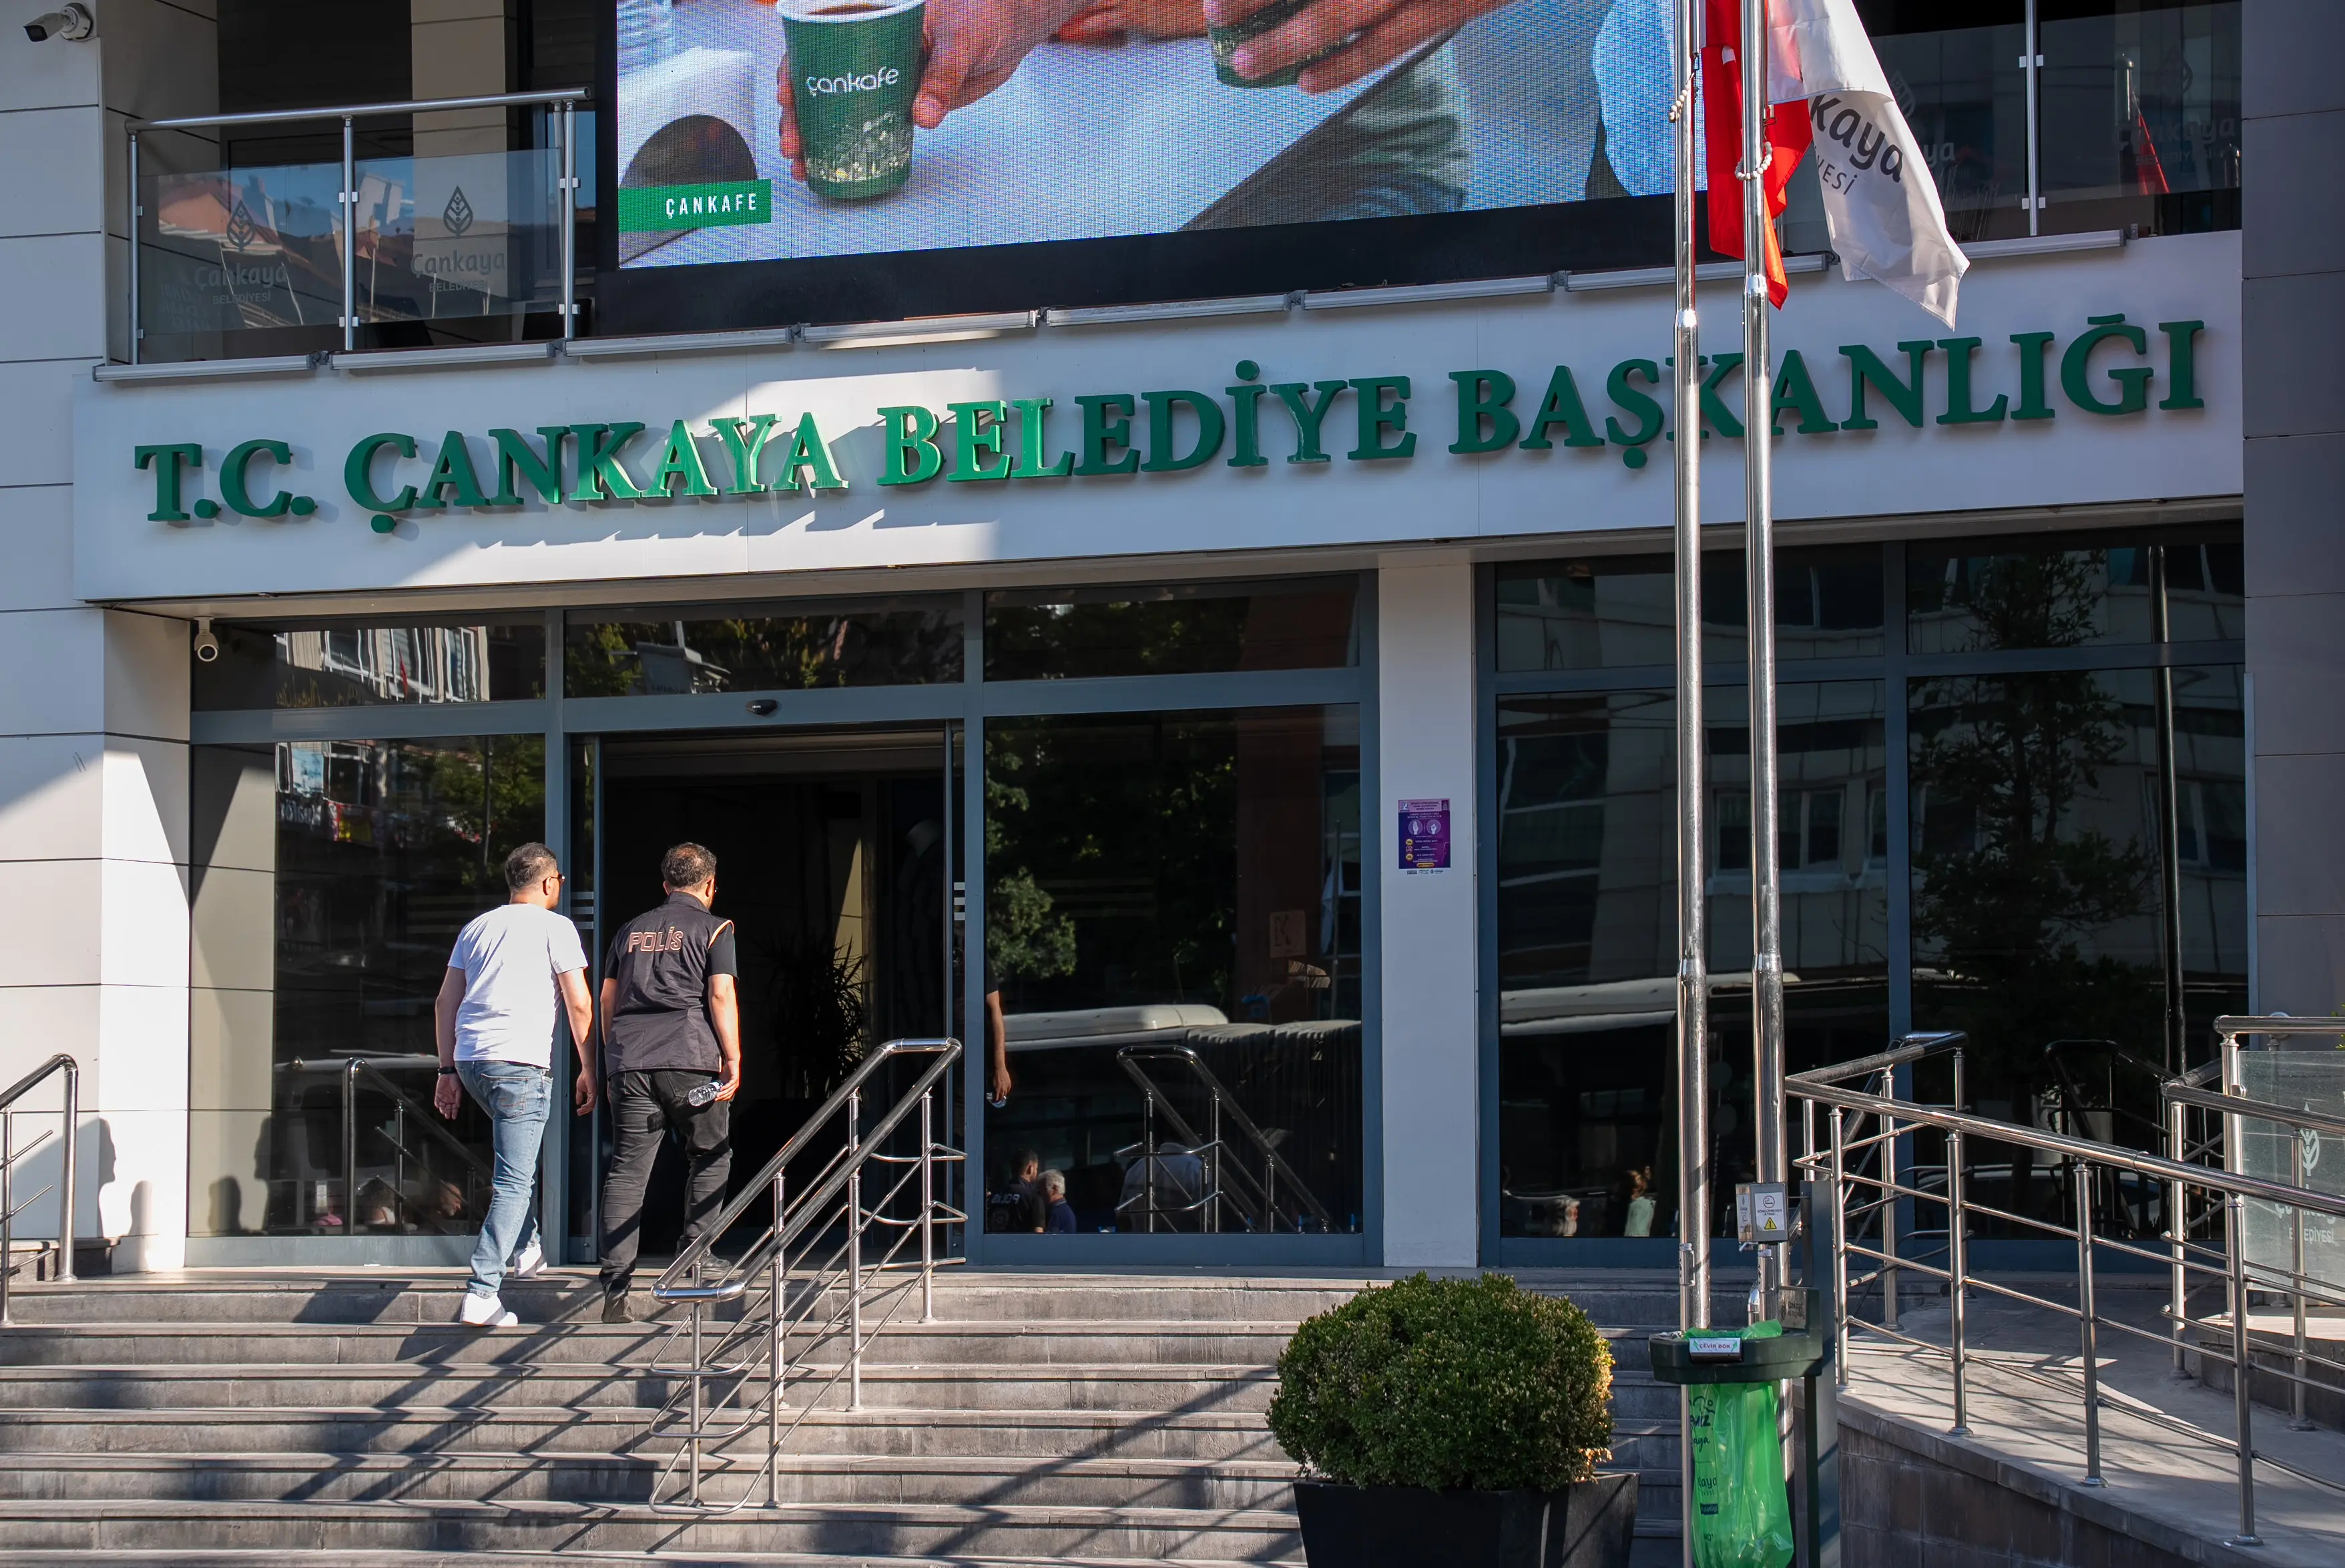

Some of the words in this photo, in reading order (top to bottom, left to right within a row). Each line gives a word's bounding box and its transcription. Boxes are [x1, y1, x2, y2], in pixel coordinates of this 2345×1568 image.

[666, 193, 757, 220] ÇANKAFE
[194, 262, 288, 290] Çankaya
[411, 250, 506, 278] Çankaya
[134, 439, 316, 521] T.C.
[344, 411, 849, 533] ÇANKAYA
[876, 359, 1416, 486] BELEDİYE
[1450, 314, 2204, 469] BAŞKANLIĞI
[628, 926, 684, 953] POLİS
